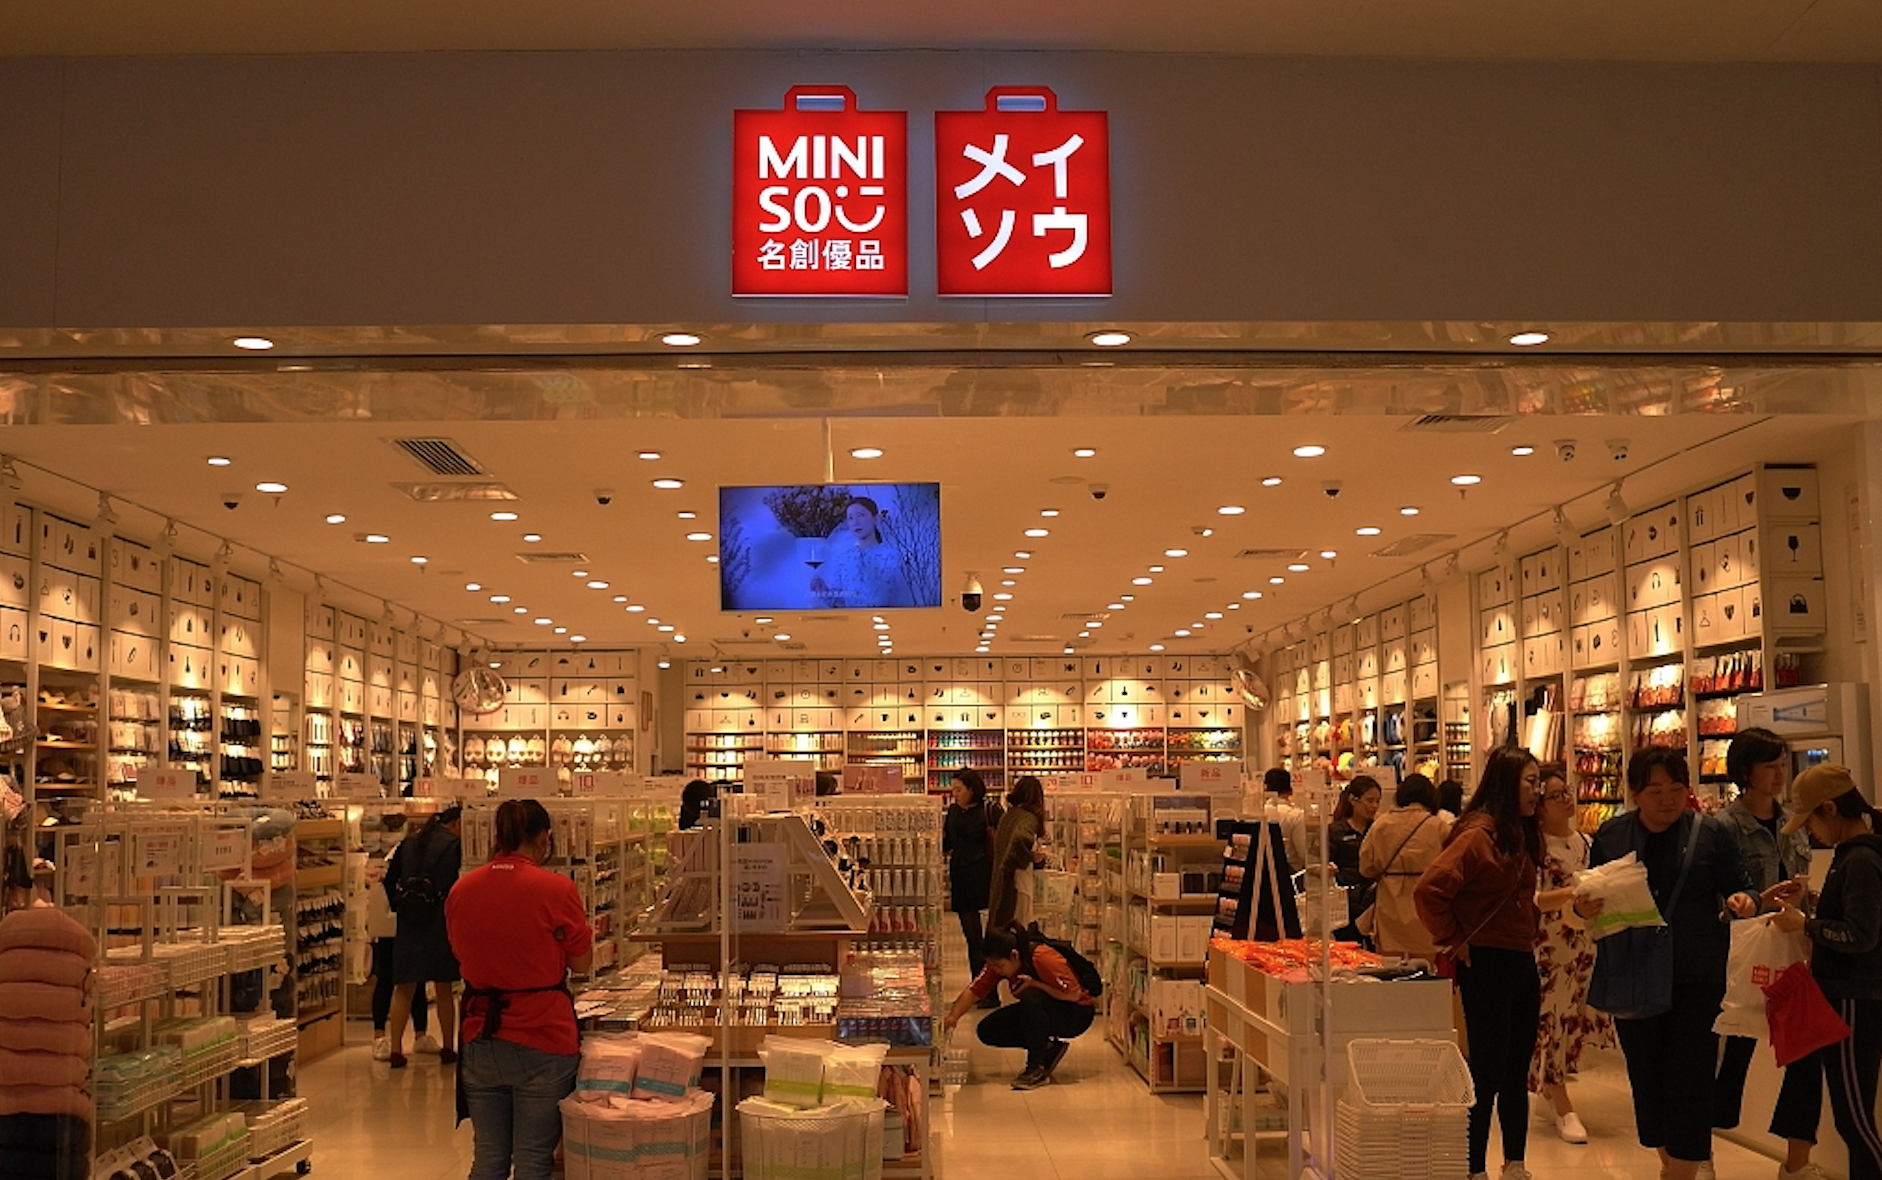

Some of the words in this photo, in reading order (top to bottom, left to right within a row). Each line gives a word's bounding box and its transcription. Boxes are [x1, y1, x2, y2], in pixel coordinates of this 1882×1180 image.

[758, 135, 885, 180] MINI
[954, 134, 1085, 201] メイ
[756, 238, 885, 271] 名創優品
[960, 206, 1089, 271] ソウ
[579, 775, 594, 788] 10
